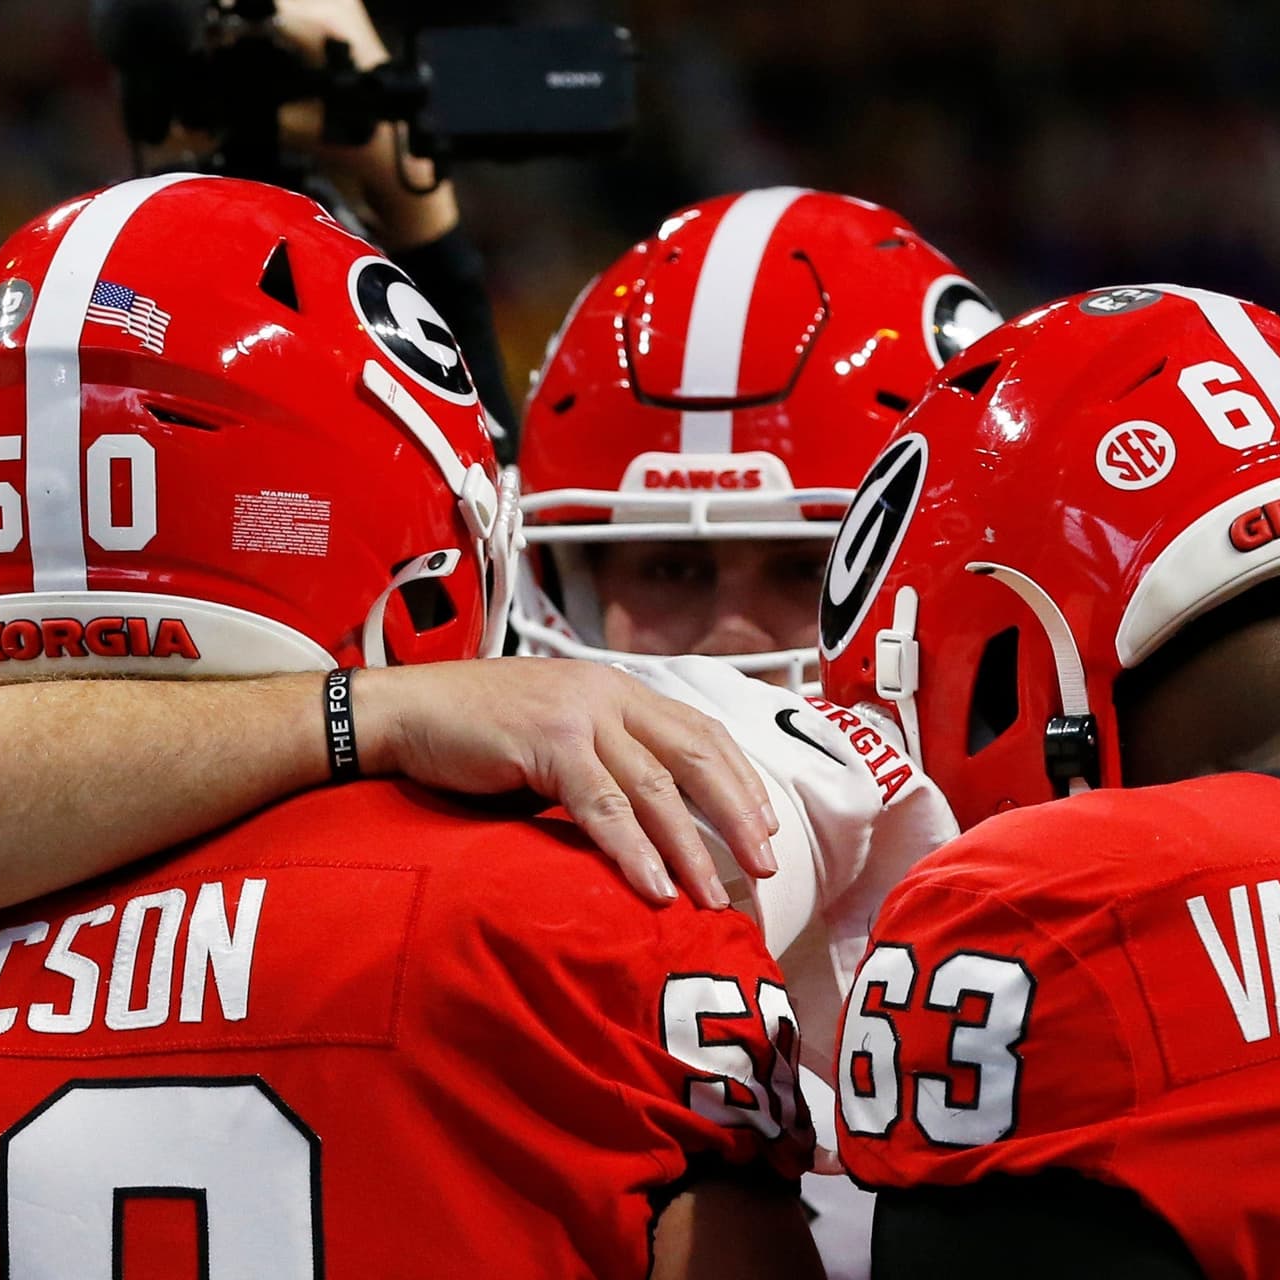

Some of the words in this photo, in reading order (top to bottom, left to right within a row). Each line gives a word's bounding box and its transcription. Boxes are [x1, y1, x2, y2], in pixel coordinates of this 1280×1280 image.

[1103, 426, 1168, 483] SEC
[260, 489, 310, 500] WARNING
[644, 469, 762, 490] DAWGS
[331, 719, 353, 768] THE
[834, 941, 1038, 1148] 63
